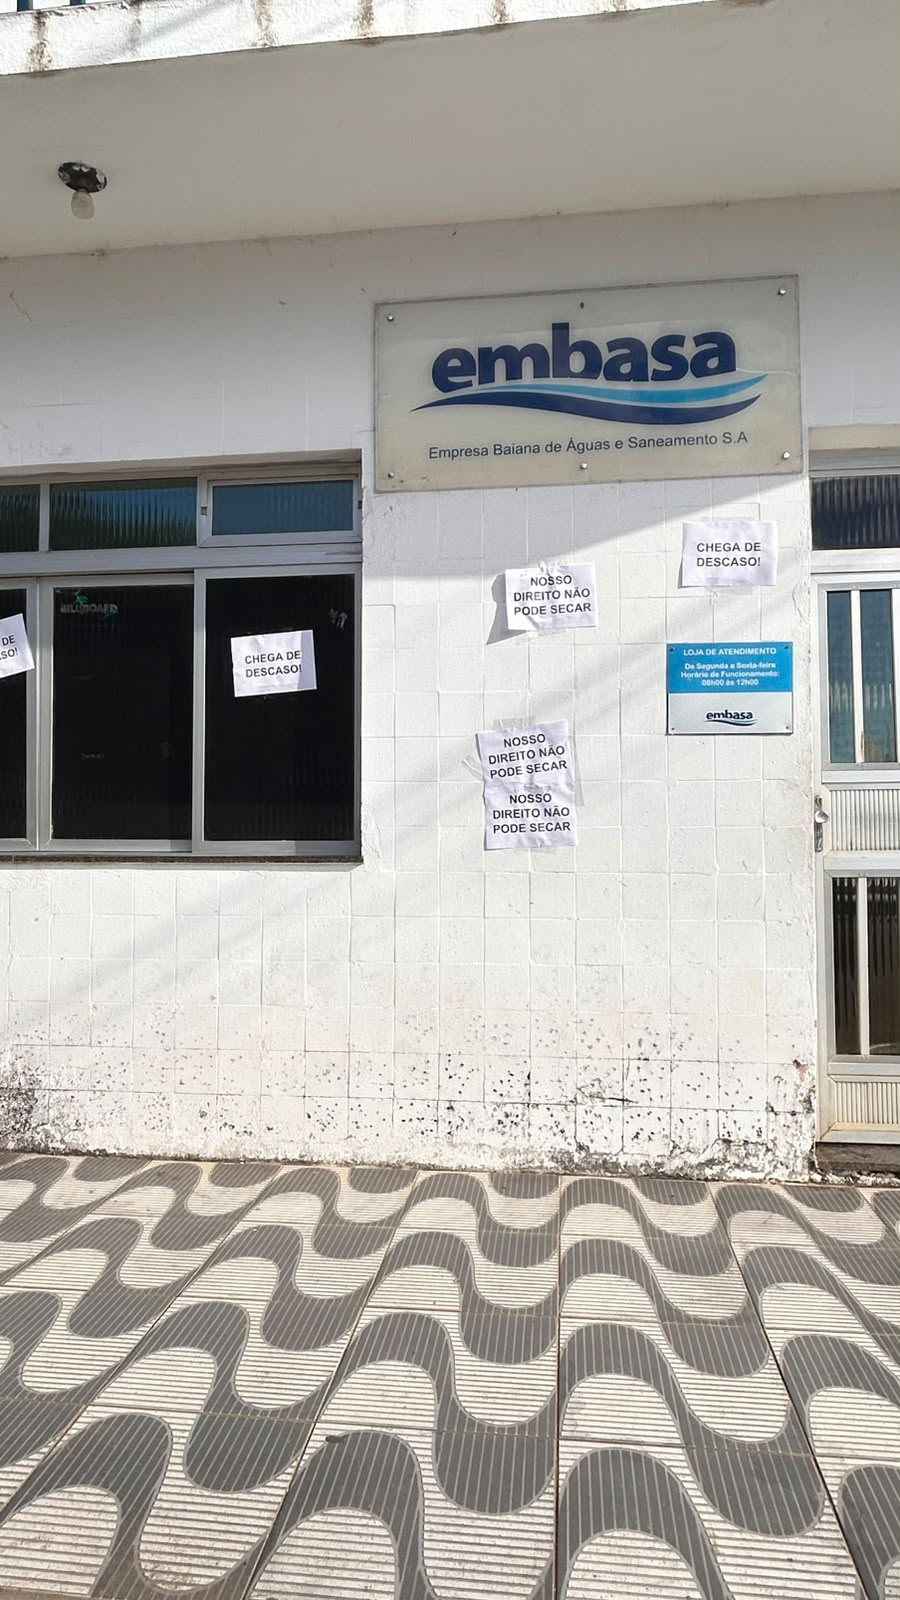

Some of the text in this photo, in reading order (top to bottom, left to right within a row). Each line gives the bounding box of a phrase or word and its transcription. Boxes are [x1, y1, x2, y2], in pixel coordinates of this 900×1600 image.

[431, 322, 737, 393] embasa
[428, 431, 749, 460] Empresa Baiana de Águas e Saneamento S.A
[696, 542, 762, 552] CHEGA DE
[696, 557, 761, 567] DESCASO!
[530, 574, 572, 586] NOSSO
[513, 586, 590, 602] DIREITO NÃO
[513, 602, 592, 616] PODE SECAR
[1, 634, 16, 646] DE
[244, 650, 302, 664] CHEGA DE
[683, 647, 777, 656] LOJA DE ATENDIMENTO
[245, 664, 302, 678] DESCASO!
[696, 662, 729, 670] Segunda
[720, 670, 779, 678] Funcionamento:
[706, 709, 754, 720] embasa
[503, 733, 546, 748] NOSSO
[488, 745, 565, 765] DIREITO NÃO
[490, 760, 568, 779] PODE SECAR
[509, 793, 552, 804] NOSSO
[493, 805, 570, 820] DIREITO NÃO
[493, 822, 571, 834] PODE SECAR
